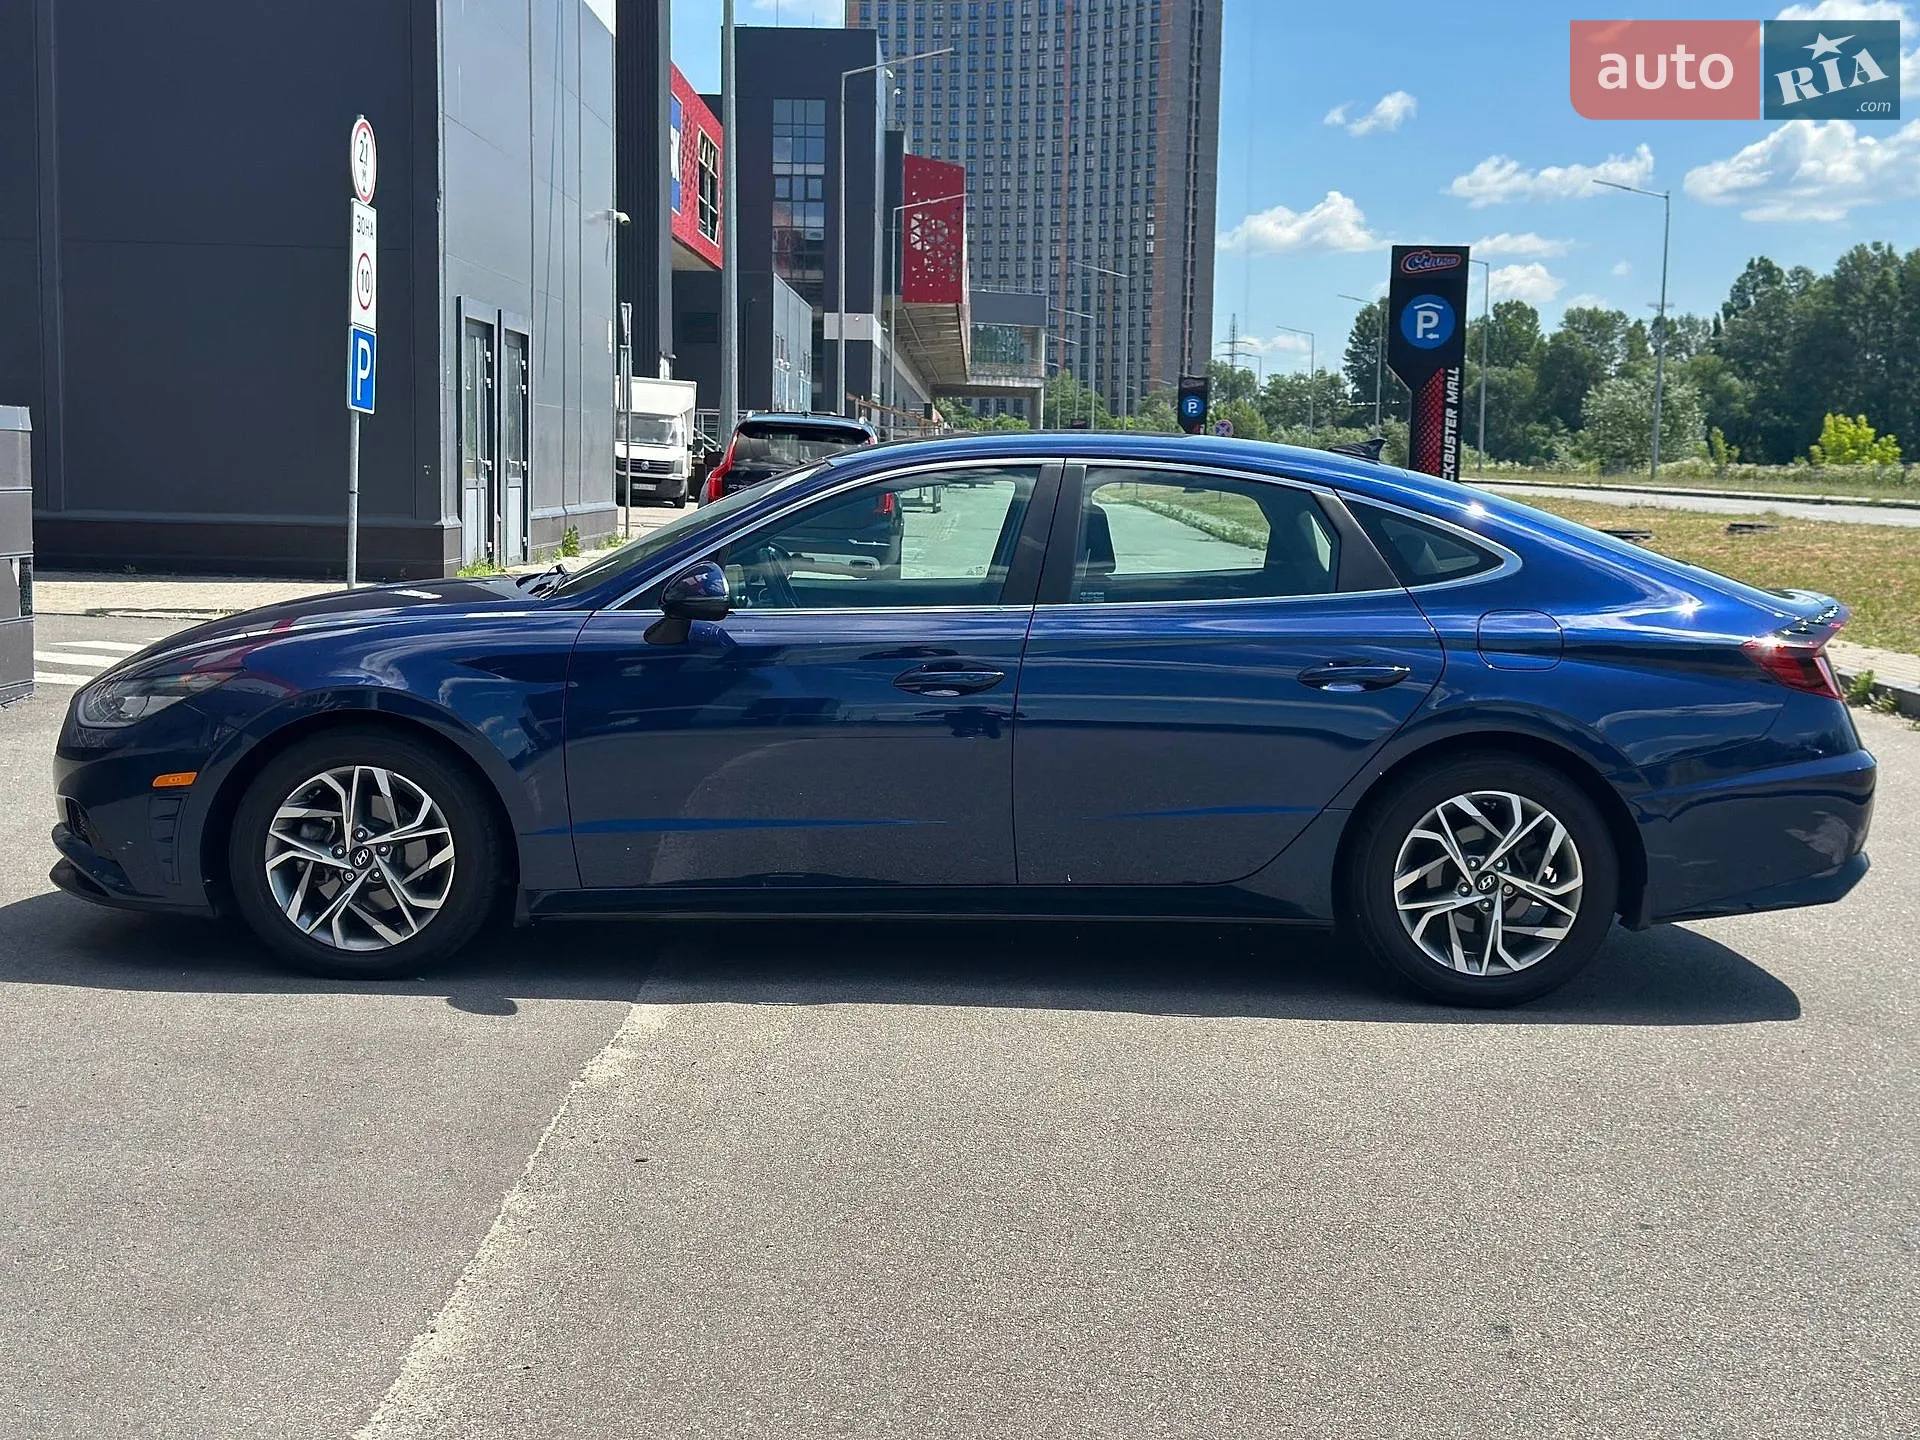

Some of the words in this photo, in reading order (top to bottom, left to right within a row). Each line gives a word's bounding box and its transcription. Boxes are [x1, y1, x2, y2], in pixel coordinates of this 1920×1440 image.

[360, 268, 371, 294] 10
[1416, 310, 1440, 339] P
[357, 337, 371, 401] P
[1446, 366, 1460, 404] MALL
